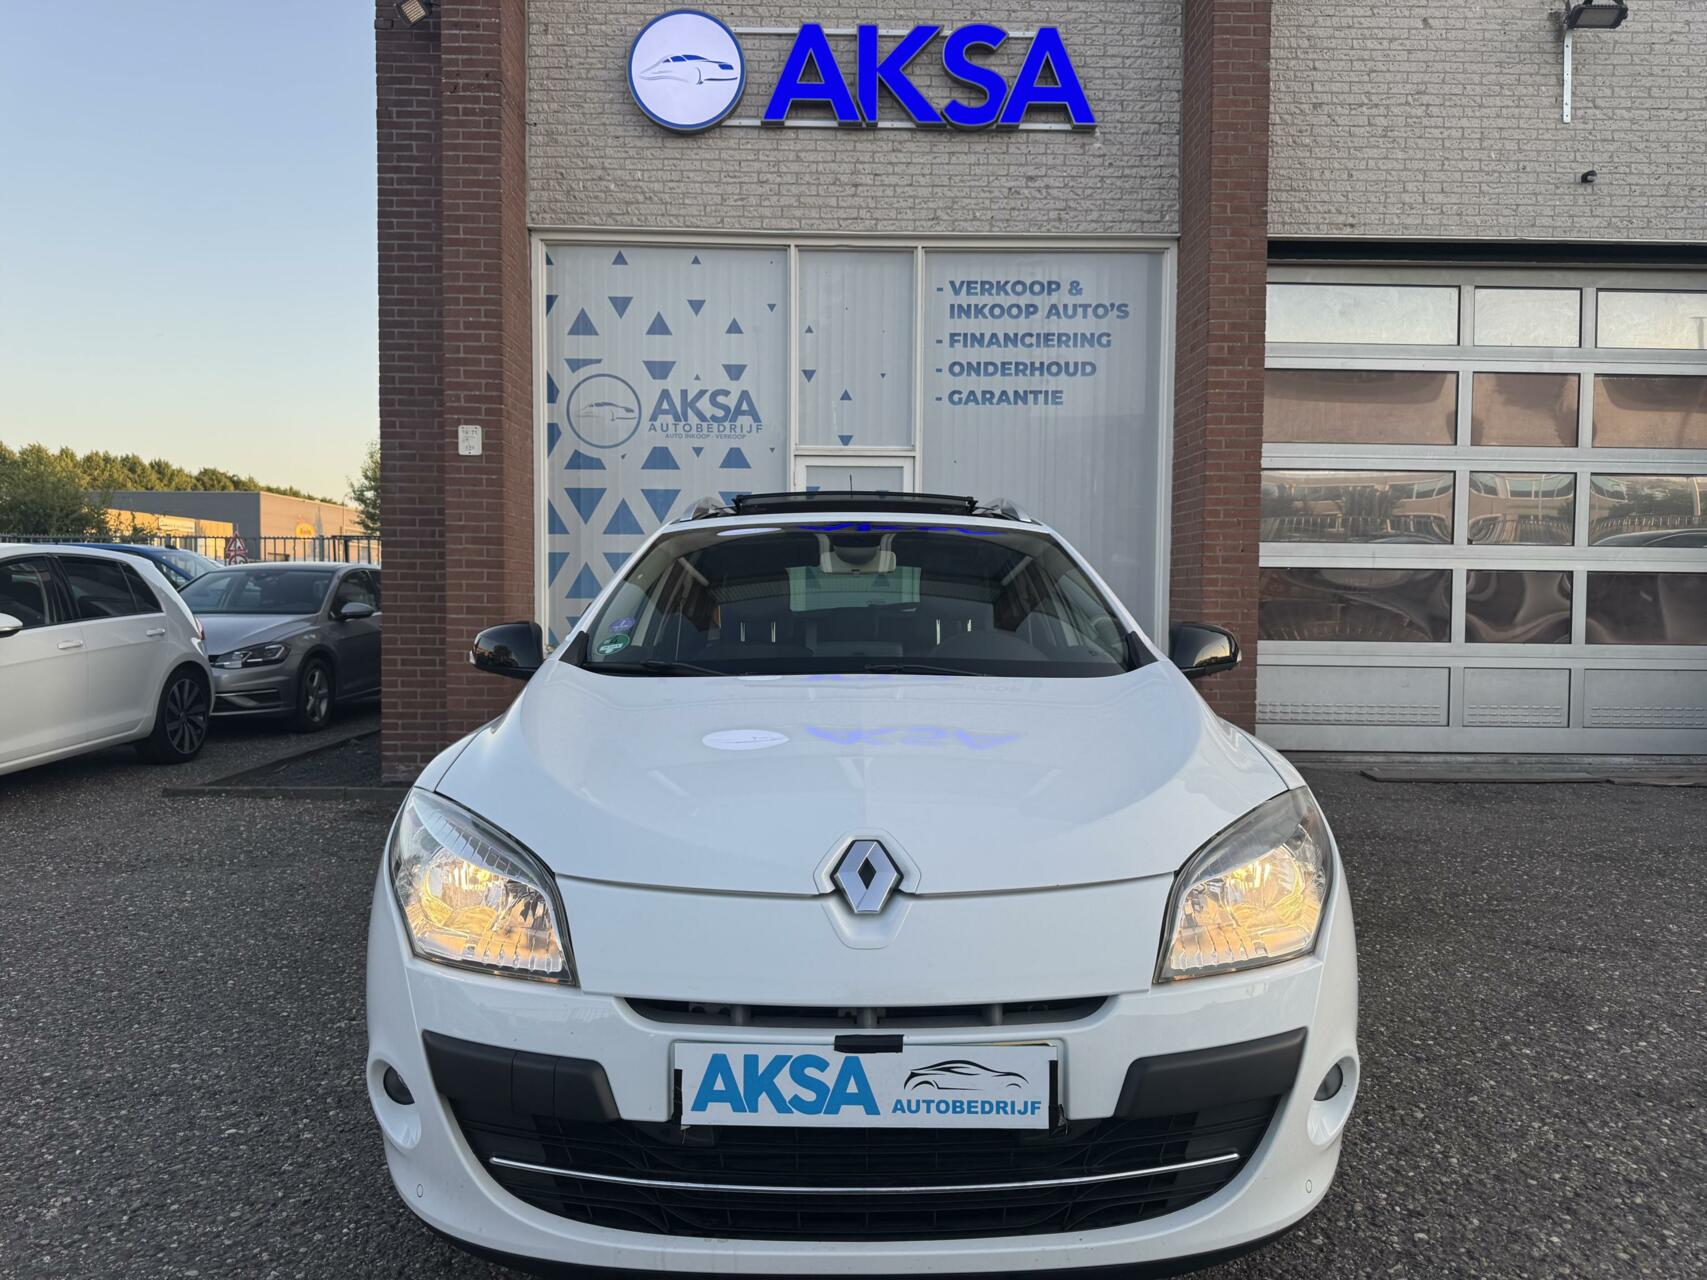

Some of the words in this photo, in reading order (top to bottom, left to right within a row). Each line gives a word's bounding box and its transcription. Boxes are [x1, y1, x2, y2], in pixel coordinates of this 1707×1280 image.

[761, 22, 1097, 130] AKSA
[949, 280, 1061, 296] VERKOOP
[1068, 280, 1083, 296] &
[949, 303, 1039, 319] INKOOP
[1045, 303, 1129, 320] AUTO’S
[949, 332, 1112, 348] FINANCIERING
[948, 361, 1097, 377] ONDERHOUD
[649, 388, 762, 423] AKSA
[948, 390, 1064, 406] GARANTIE
[648, 423, 763, 433] AUTOBEDRIJF
[691, 1053, 880, 1116] AKSA
[891, 1099, 1041, 1115] AUTOBEDRIJF
